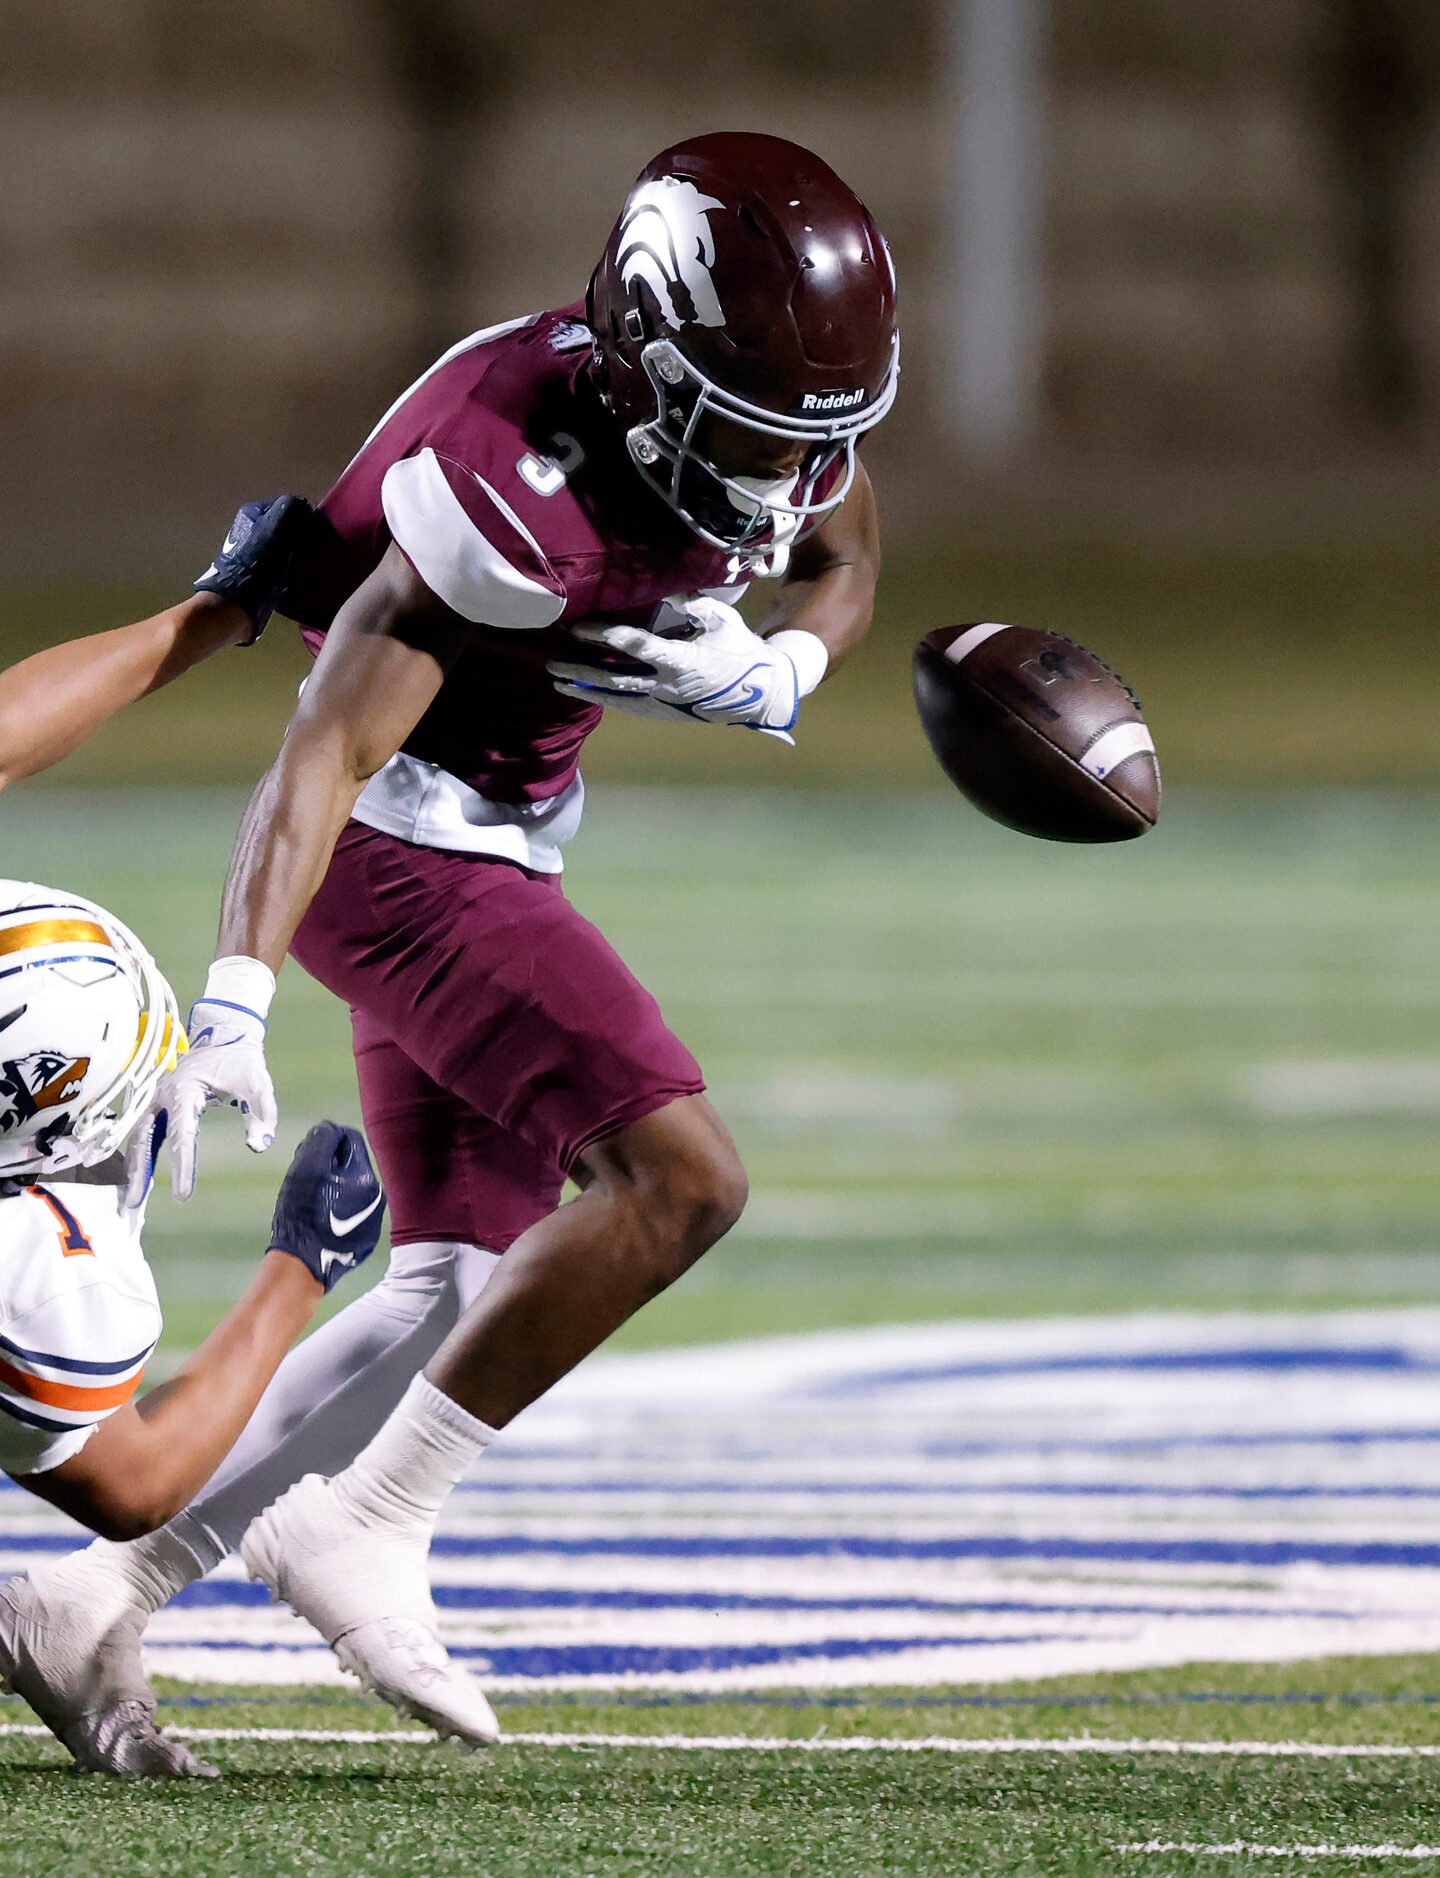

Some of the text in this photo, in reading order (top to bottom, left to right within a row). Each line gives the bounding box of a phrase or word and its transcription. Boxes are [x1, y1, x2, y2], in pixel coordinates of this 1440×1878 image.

[802, 388, 865, 409] Riddell
[516, 431, 585, 497] 3
[26, 1185, 96, 1257] 1
